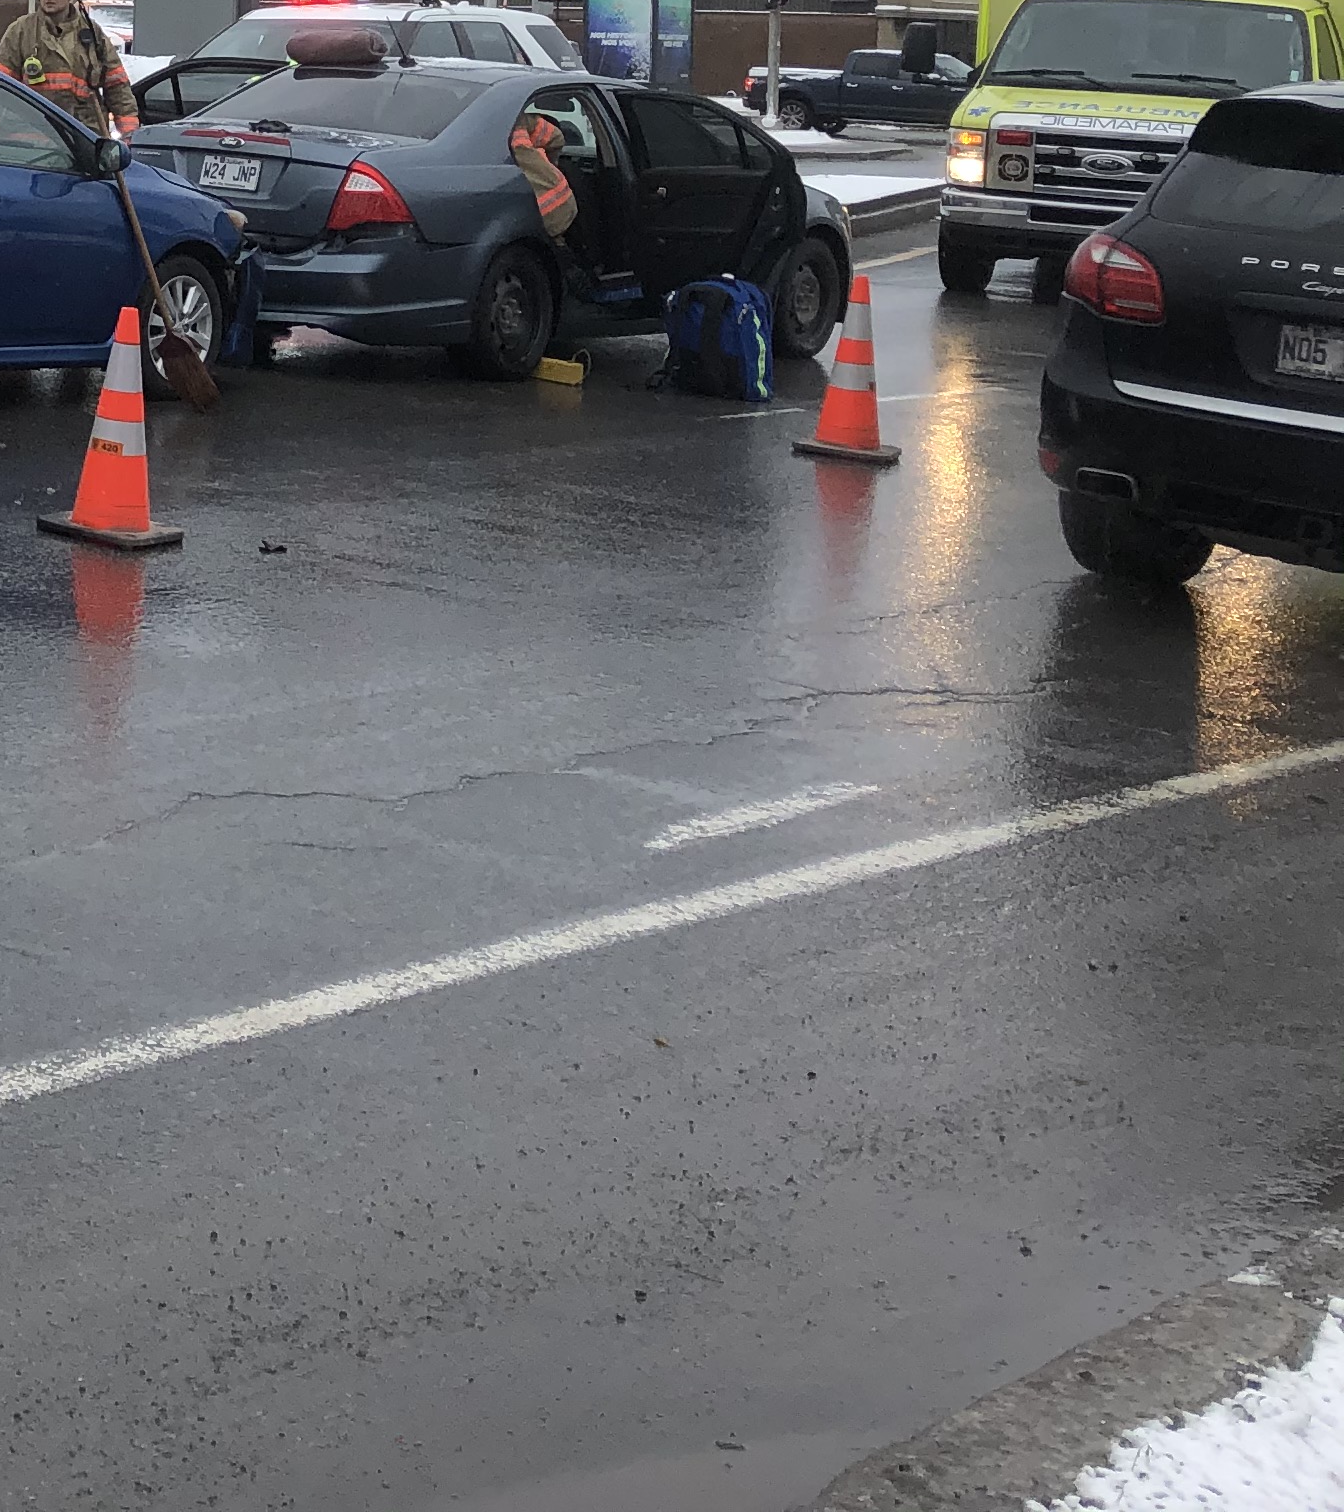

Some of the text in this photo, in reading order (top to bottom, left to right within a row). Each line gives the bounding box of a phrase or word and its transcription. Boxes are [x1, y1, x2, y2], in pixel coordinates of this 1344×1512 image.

[203, 162, 257, 183] W24 JNP
[1241, 256, 1344, 276] PORS
[101, 443, 119, 454] 420
